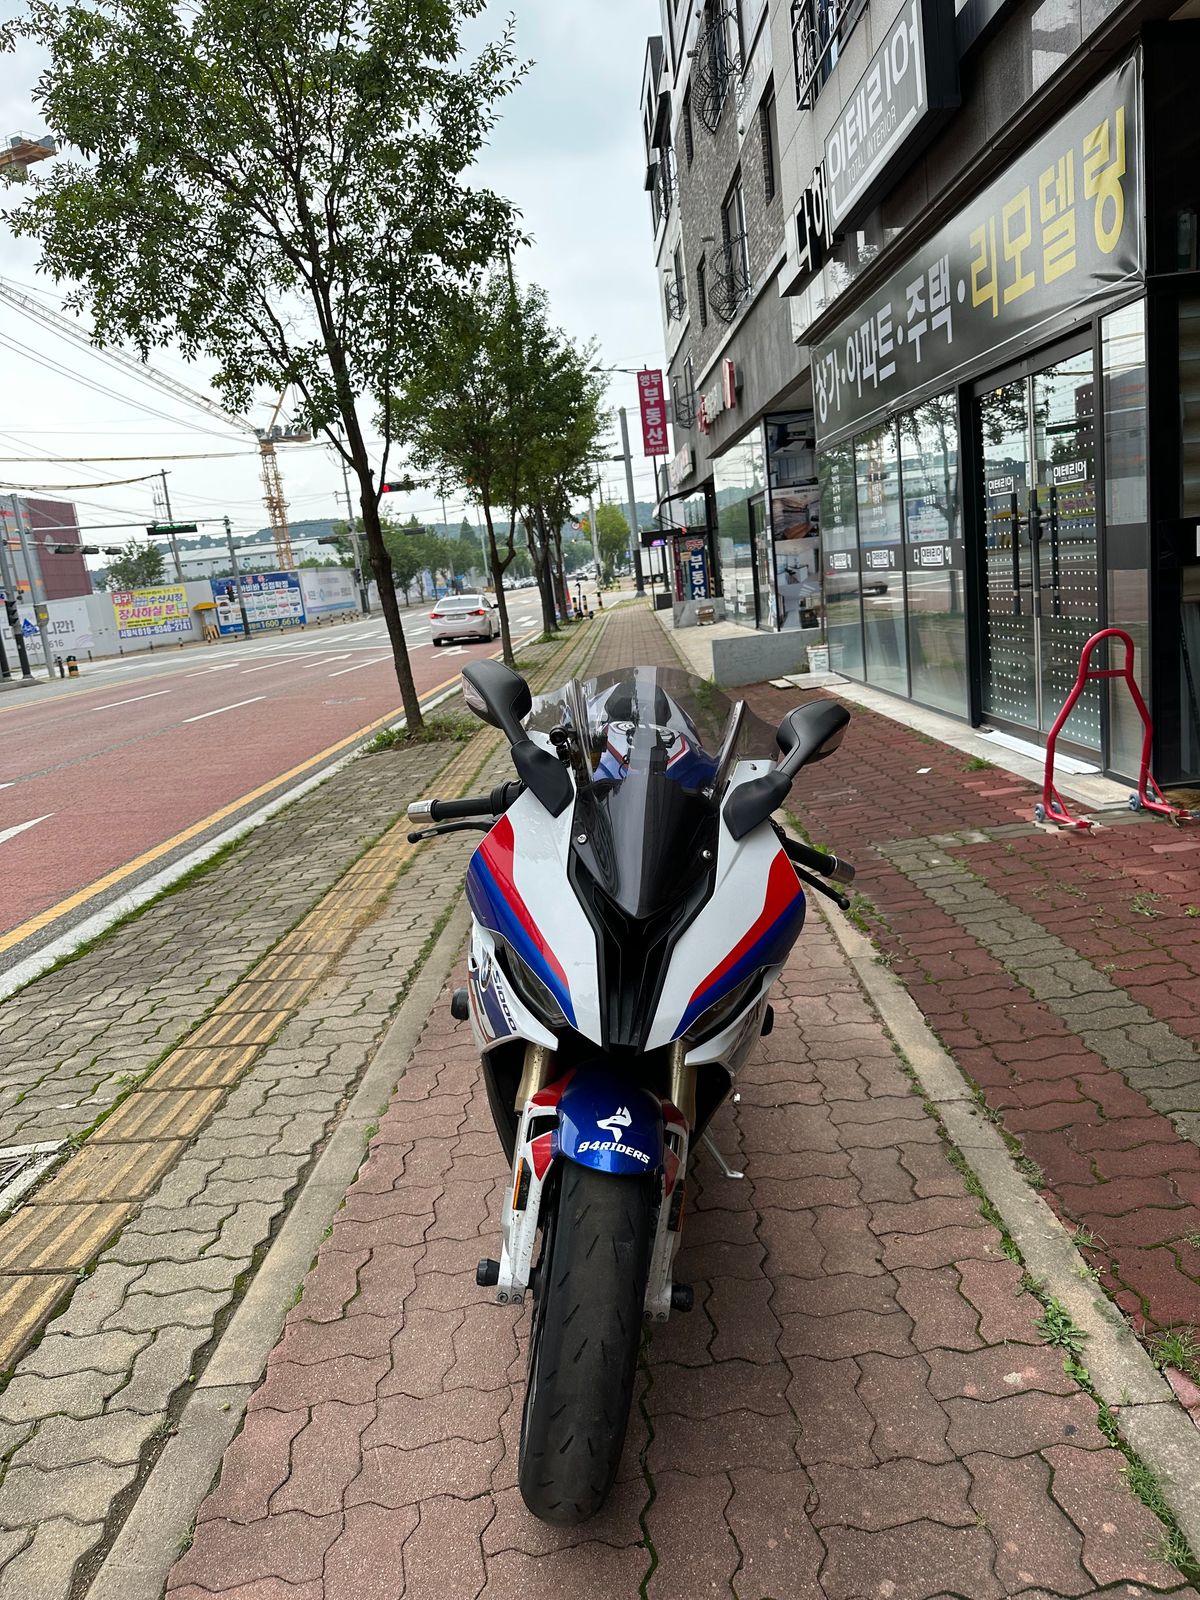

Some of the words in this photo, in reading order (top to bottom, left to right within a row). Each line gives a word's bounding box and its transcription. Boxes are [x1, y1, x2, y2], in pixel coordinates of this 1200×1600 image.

[847, 157, 865, 185] TOTAL
[866, 105, 897, 160] INTERIOR
[969, 105, 1127, 318] 리모델링
[643, 387, 664, 446] 부동산
[690, 555, 706, 600] 부동산
[576, 1140, 651, 1165] 94RIDERS
